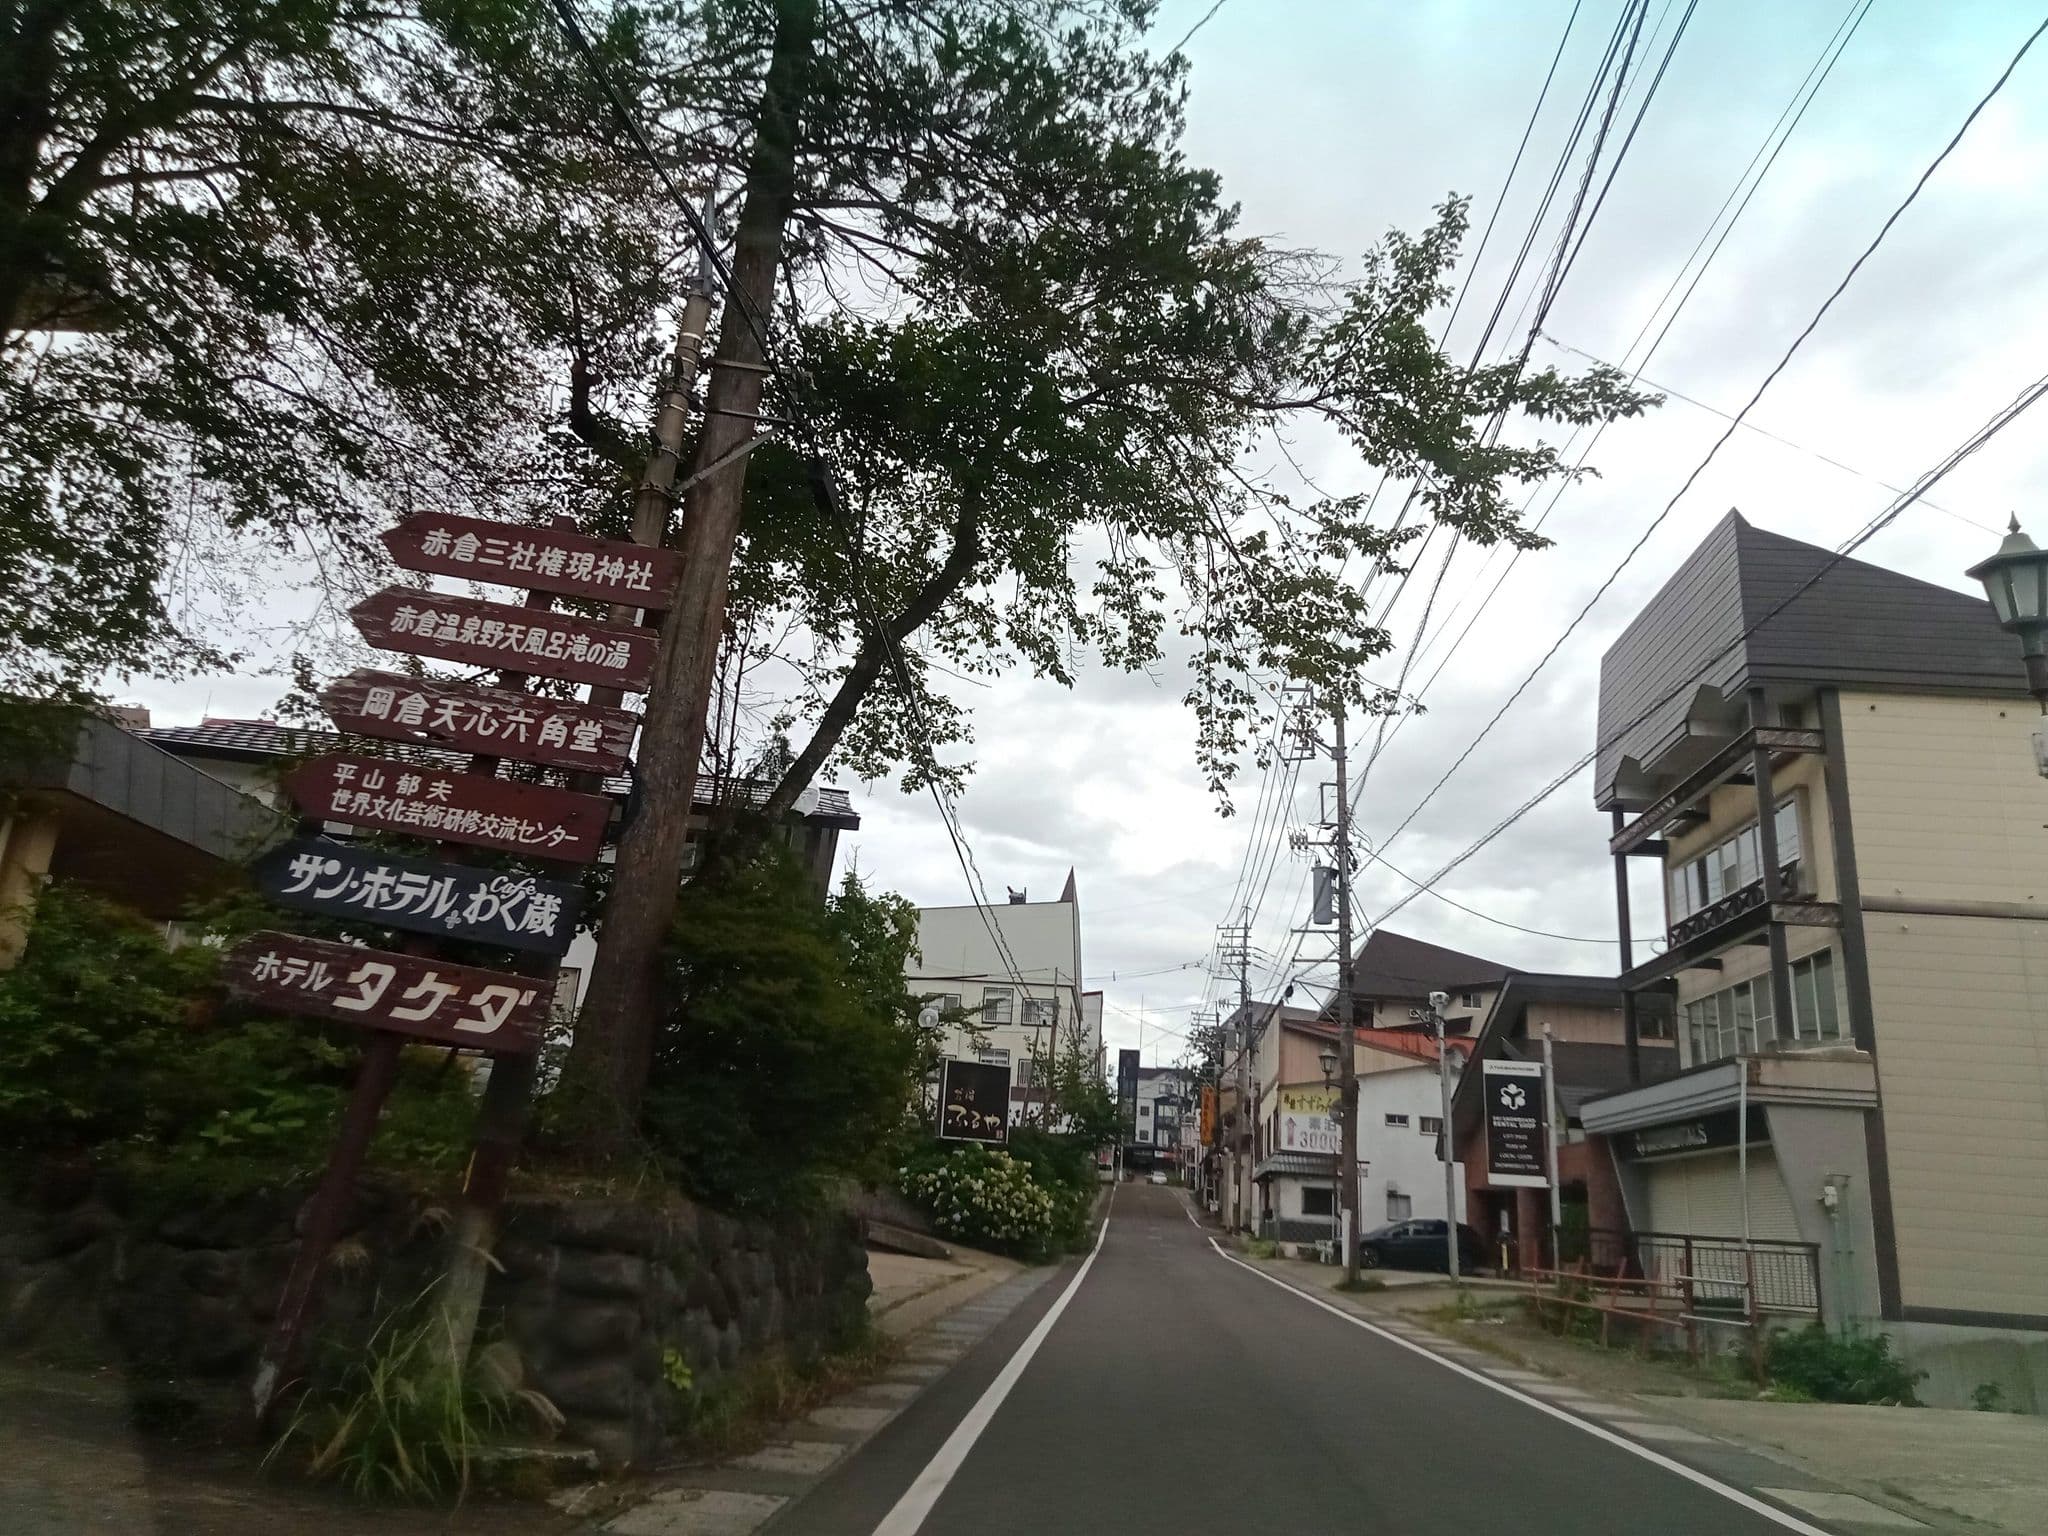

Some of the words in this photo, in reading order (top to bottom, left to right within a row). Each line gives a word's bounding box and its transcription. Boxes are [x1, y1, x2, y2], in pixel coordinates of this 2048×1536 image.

[421, 527, 654, 592] 赤倉三社権現神社
[389, 604, 632, 670] 赤倉温泉野天風呂滝の湯
[360, 686, 603, 754] 岡倉天心六角堂
[333, 762, 454, 802] 平山郁夫
[330, 788, 580, 848] 世界文化芸術研修交流センター
[462, 882, 563, 938] わく蔵
[251, 951, 336, 993] ホテル
[332, 961, 538, 1034] タケダ
